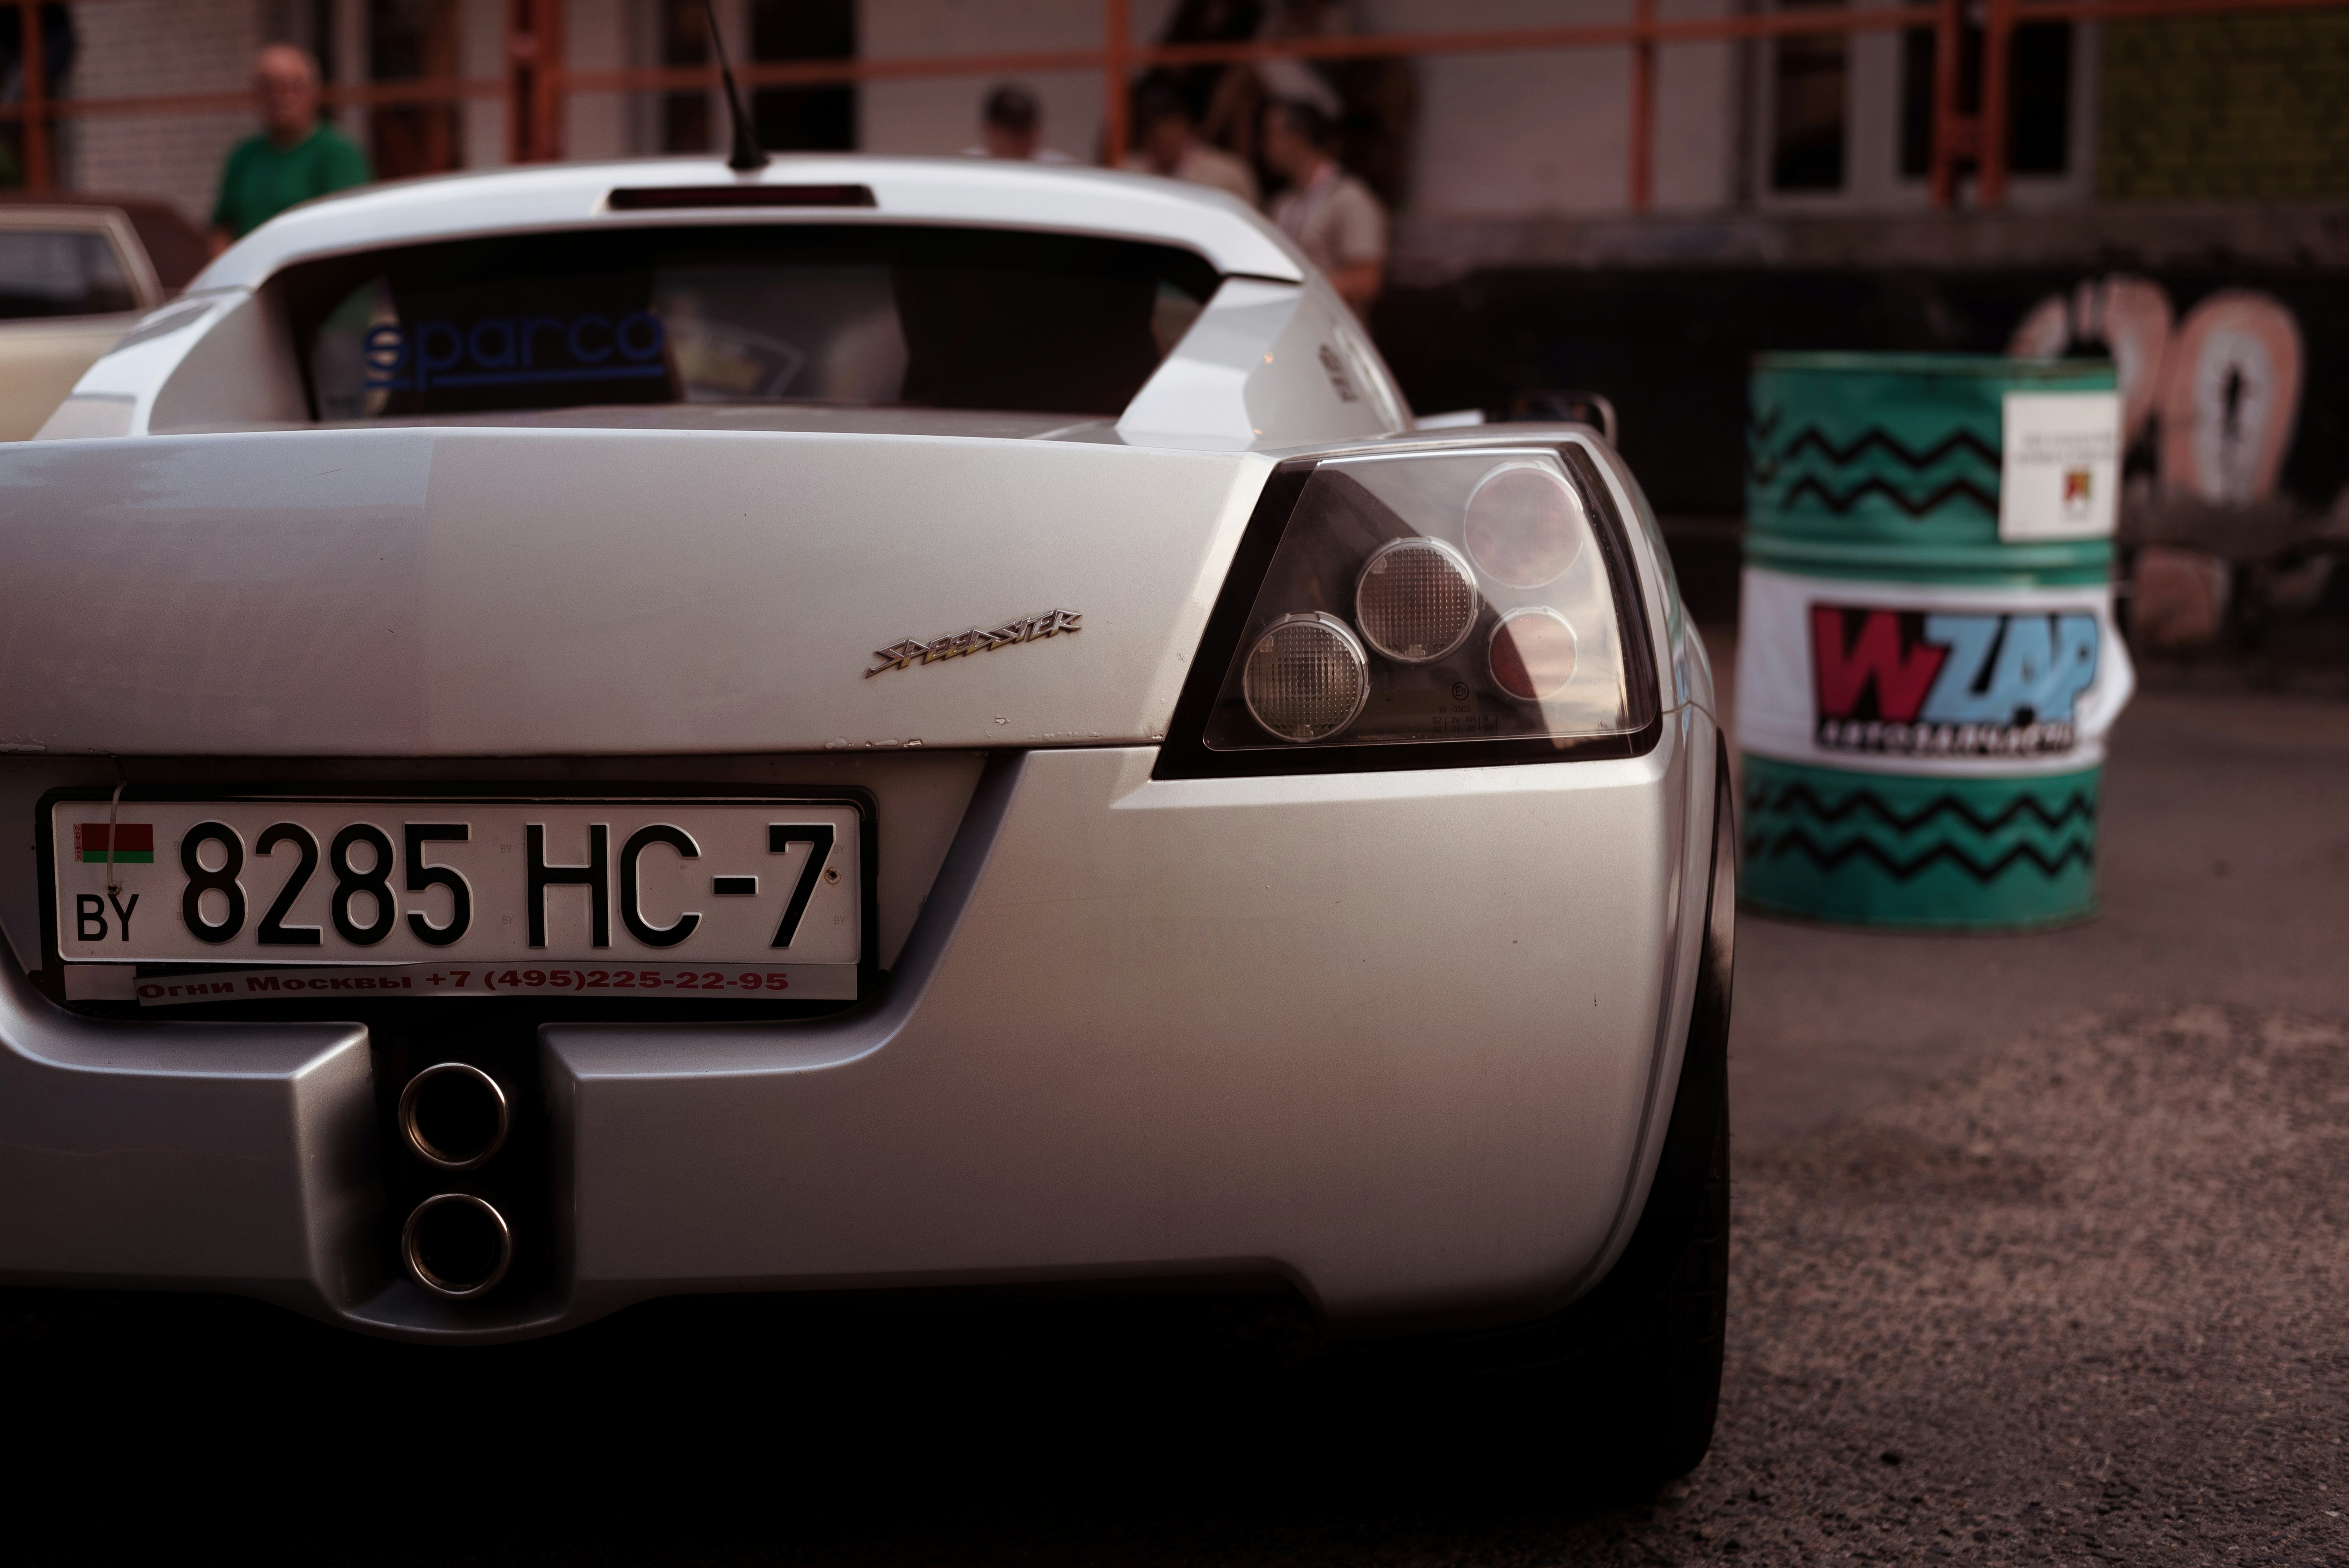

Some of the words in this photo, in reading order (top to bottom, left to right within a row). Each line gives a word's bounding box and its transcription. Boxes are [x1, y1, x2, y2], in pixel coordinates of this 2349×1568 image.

[363, 311, 664, 392] sparco
[865, 609, 1082, 679] SPEEDSTER
[76, 894, 139, 941] BY
[180, 821, 470, 947] 8285
[137, 982, 234, 998] Огни
[246, 976, 412, 992] Москвы
[426, 970, 471, 988] +7
[484, 970, 789, 991] (495)225-22-95
